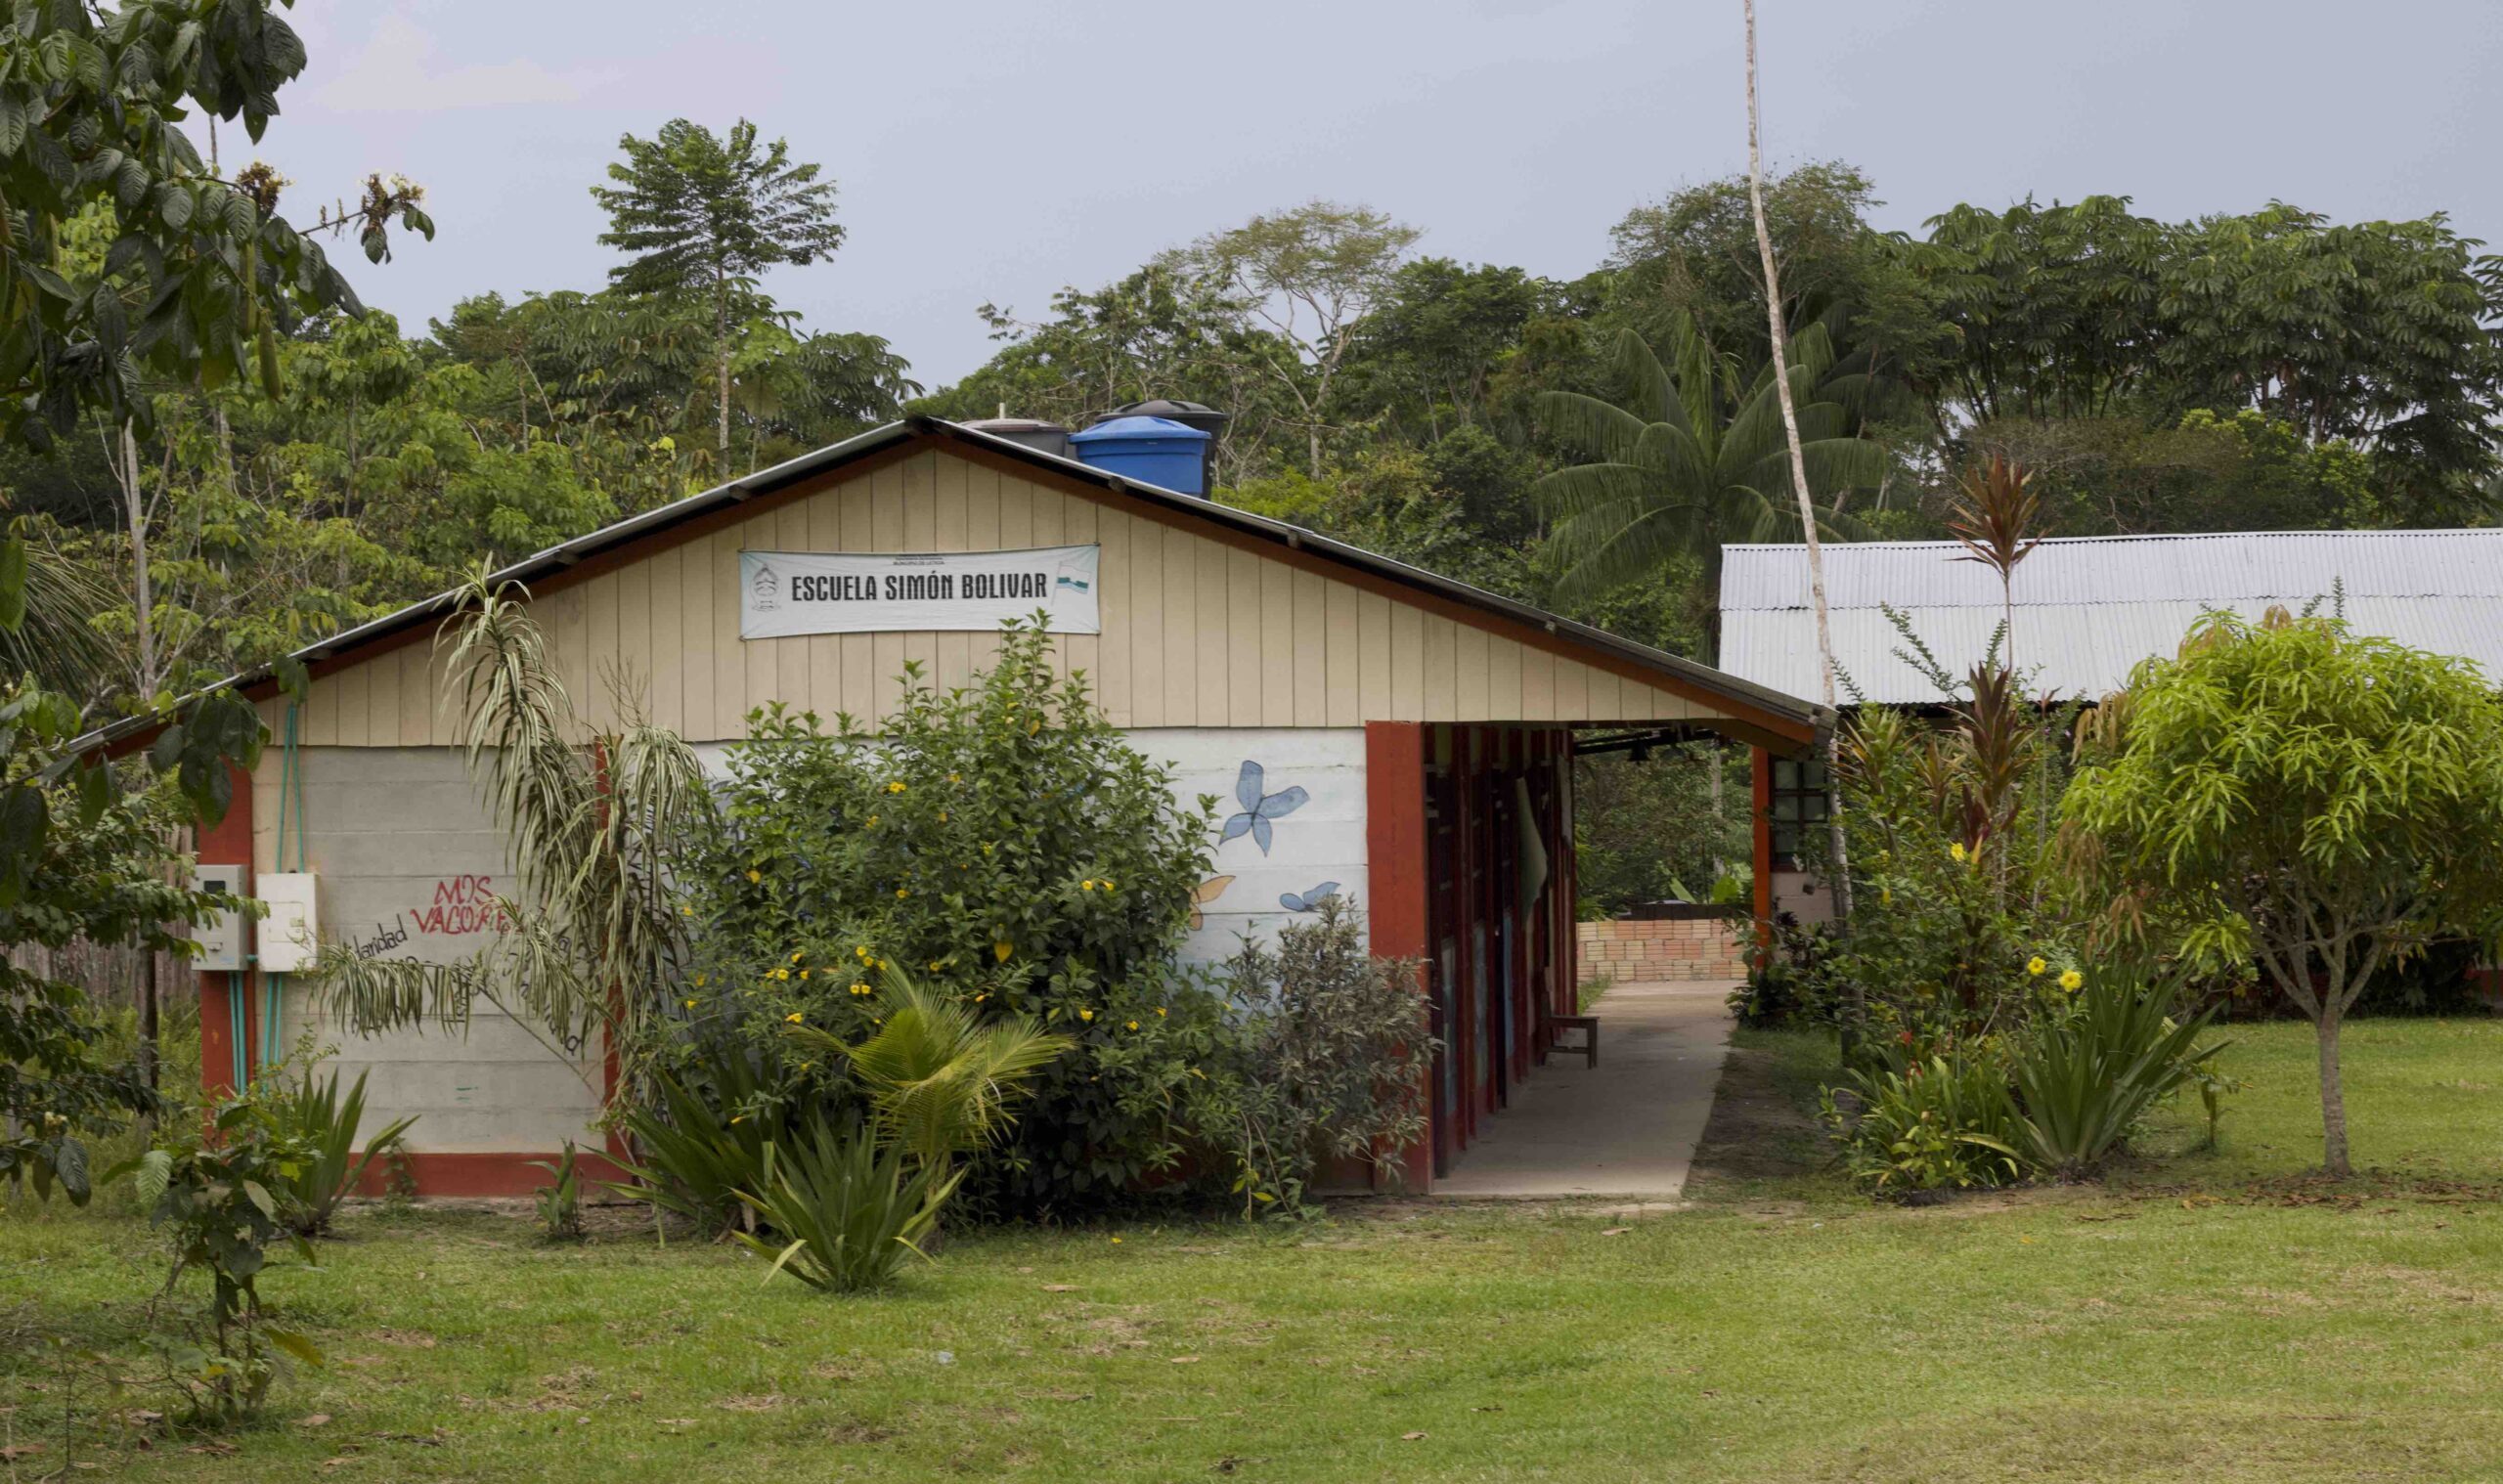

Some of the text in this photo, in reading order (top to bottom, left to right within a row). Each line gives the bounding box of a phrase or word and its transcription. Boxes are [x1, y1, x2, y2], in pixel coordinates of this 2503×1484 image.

[791, 570, 1047, 601] ESCUELA SIMÓN BOLIVAR
